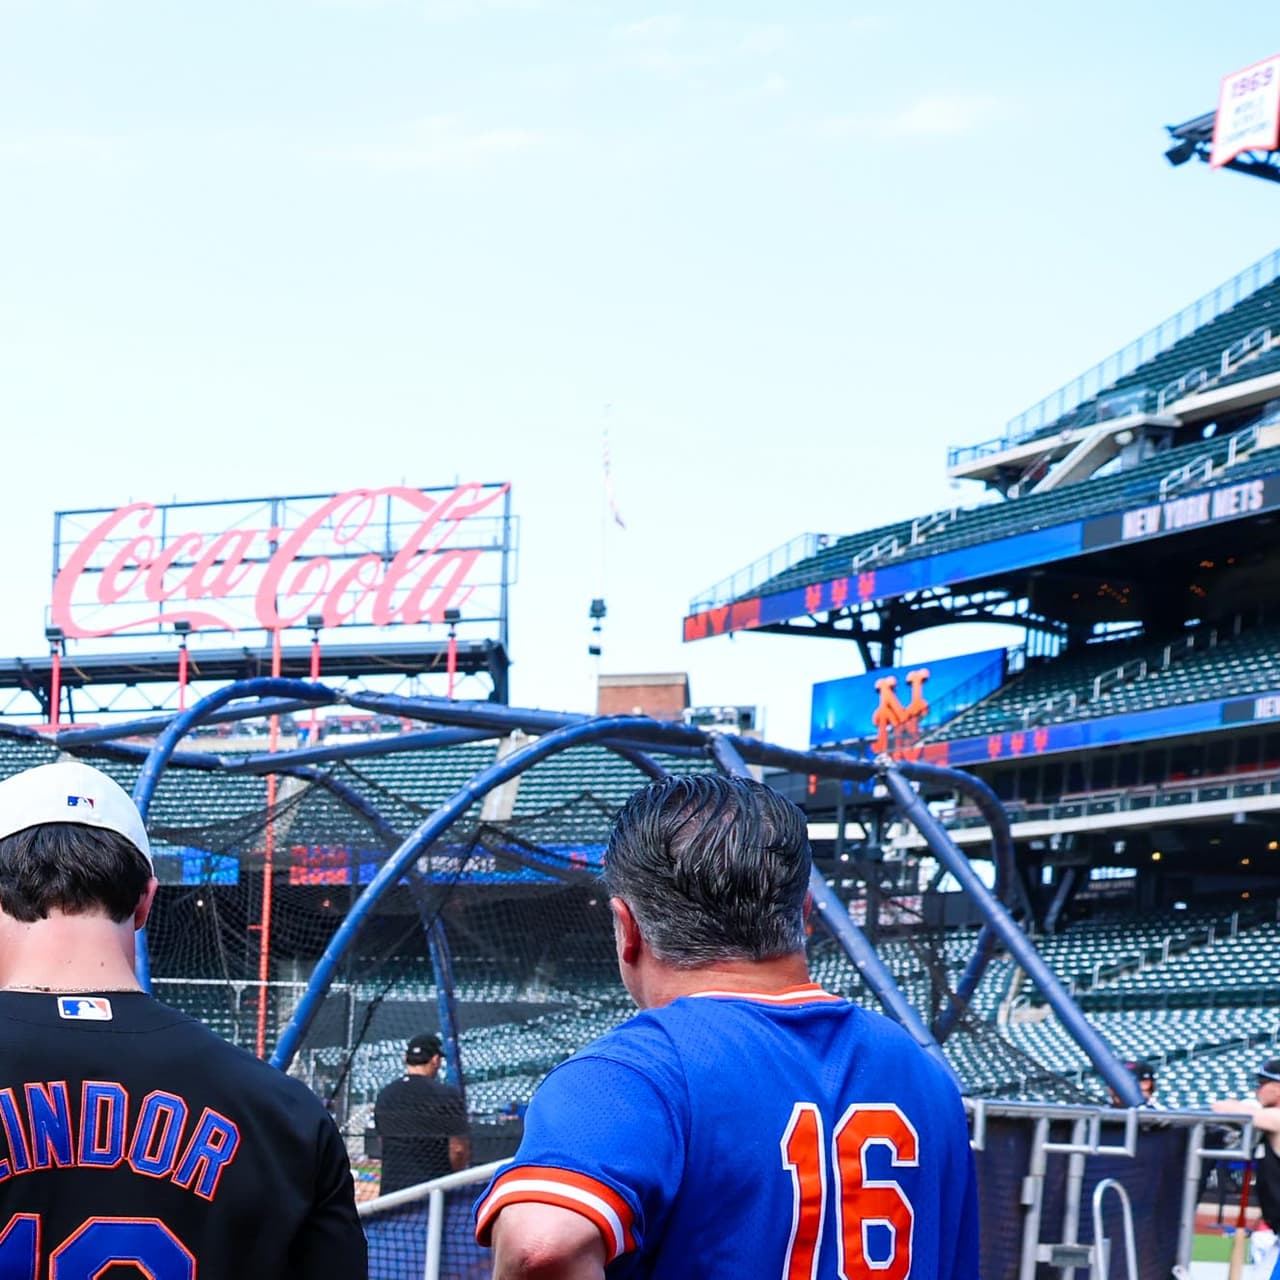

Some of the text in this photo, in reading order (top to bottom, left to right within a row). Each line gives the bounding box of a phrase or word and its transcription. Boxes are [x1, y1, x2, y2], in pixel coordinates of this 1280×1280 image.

[52, 482, 511, 639] Coca-Cola
[1122, 479, 1264, 541] NEW YORK METS
